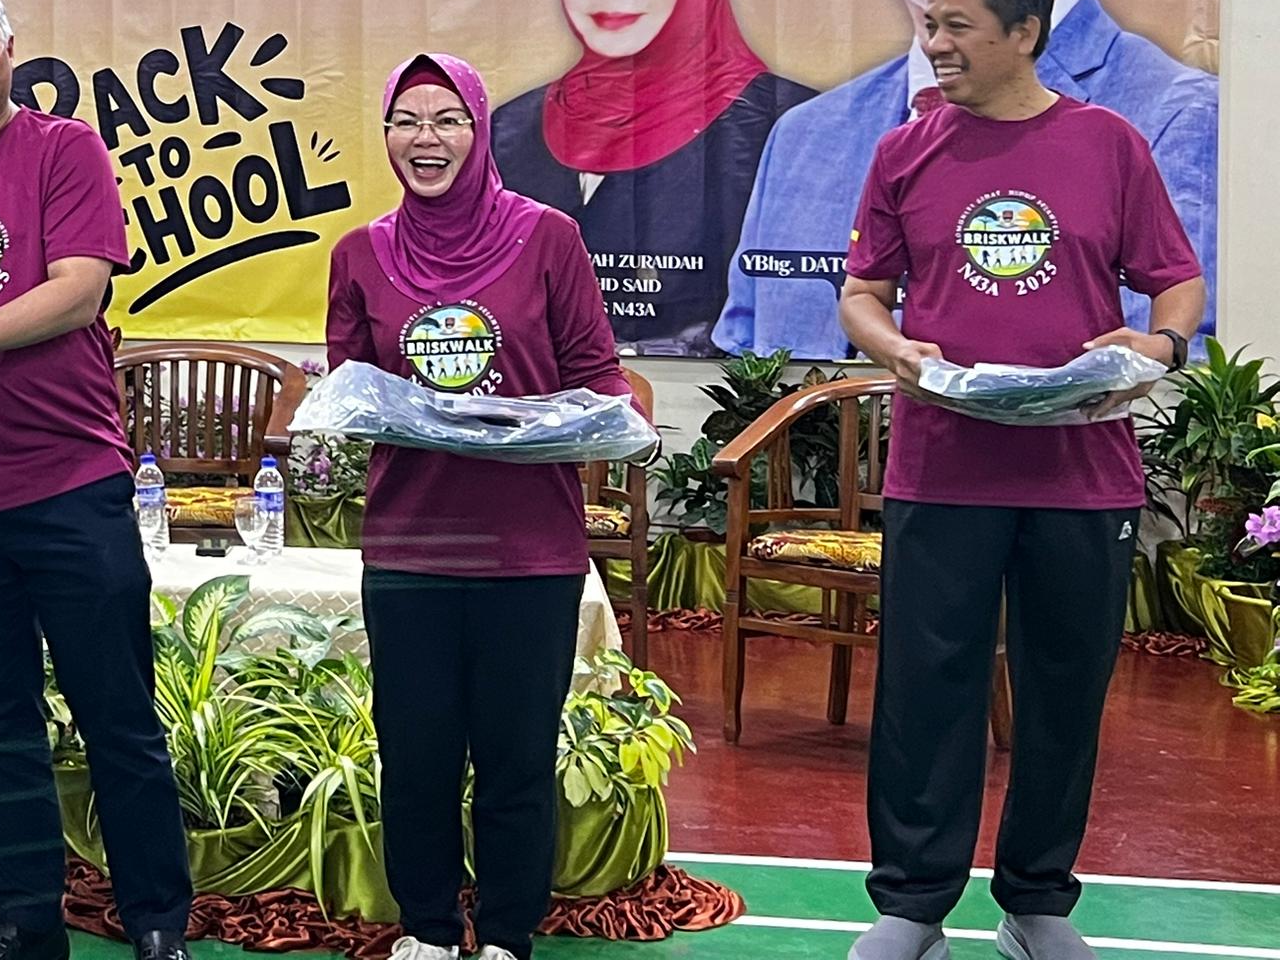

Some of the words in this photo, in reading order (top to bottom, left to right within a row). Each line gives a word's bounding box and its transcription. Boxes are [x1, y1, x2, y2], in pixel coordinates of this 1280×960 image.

[119, 136, 191, 187] TO
[111, 121, 352, 276] HOOL
[963, 232, 1051, 245] BRISKWALK
[587, 253, 614, 268] AH
[618, 254, 704, 270] ZURAIDAH
[742, 254, 795, 277] YBhg.
[622, 278, 662, 293] SAID
[957, 262, 999, 296] N43A
[1015, 260, 1057, 296] 2025
[612, 302, 656, 317] N43A
[407, 339, 495, 355] BRISKWALK
